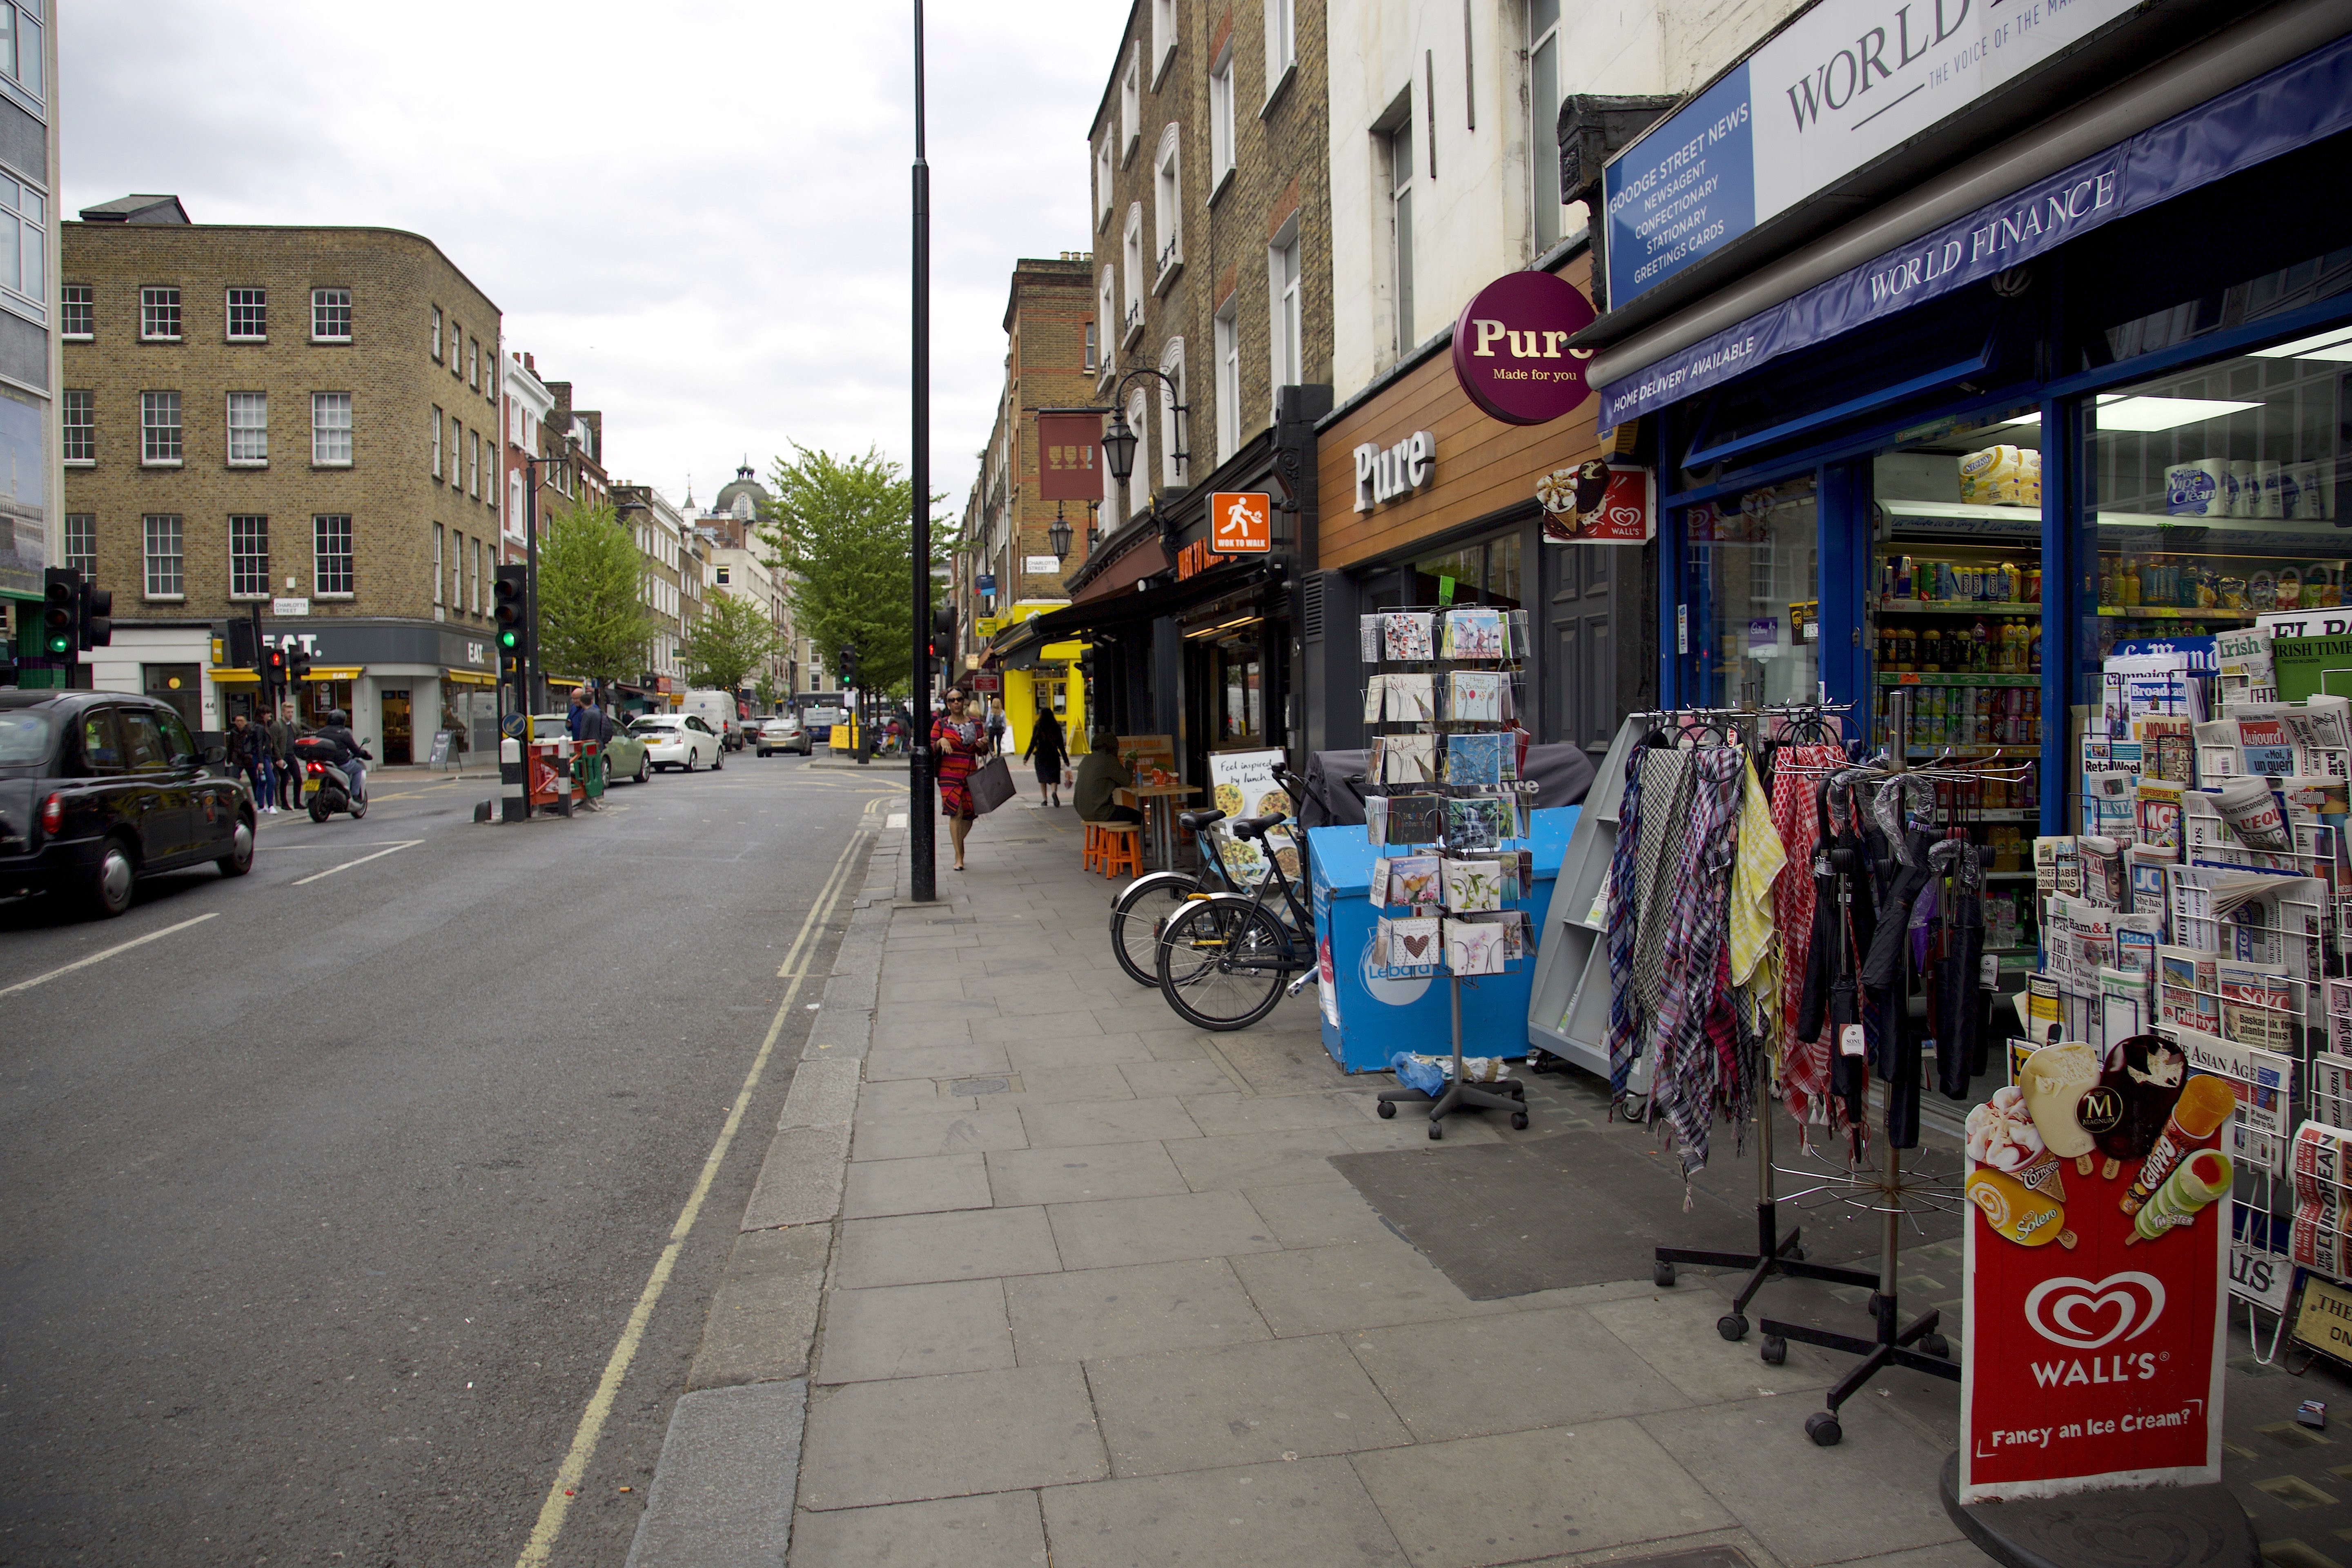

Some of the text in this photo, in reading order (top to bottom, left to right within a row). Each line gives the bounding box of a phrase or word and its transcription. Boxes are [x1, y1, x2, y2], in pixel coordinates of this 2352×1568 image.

[1929, 0, 2074, 89] THE VOICE OF THE MA
[1786, 0, 1971, 134] WORLD
[1610, 102, 1748, 215] GOODGE STREET NEWS
[1644, 160, 1706, 213] NEWSAGENT
[1635, 175, 1718, 240] CONFECTIONARY
[1646, 206, 1707, 255] STATIONARY
[1870, 169, 2115, 303] WORLD FINANCE
[1634, 219, 1724, 284] GREETINGS CARDS
[1493, 368, 1577, 383] Made for you
[1614, 336, 1755, 412] HOME DELIVERY AVAILABLE
[1353, 431, 1436, 513] Pure
[1965, 453, 1993, 474] NICKY
[2166, 475, 2201, 490] Wipe
[2172, 489, 2216, 504] Clean
[1611, 527, 1639, 535] WALL'S
[468, 642, 484, 664] EAT.
[2218, 636, 2261, 658] Irish
[2272, 643, 2312, 657] IRISH
[1389, 680, 1407, 691] Wife
[1466, 682, 1490, 691] Birthday!
[1470, 675, 1485, 684] Happy
[2132, 684, 2185, 697] Broadcast
[2243, 726, 2290, 745] Aujourd'
[2299, 722, 2310, 734] Fillon
[1388, 737, 1416, 754] Husband
[2265, 750, 2284, 760] «Moi,
[1221, 759, 1272, 772] Feel inspired
[2254, 760, 2267, 771] un
[1231, 777, 1240, 787] by
[2140, 788, 2172, 799] SUPERSPORT
[2293, 789, 2326, 805] Libération
[2094, 801, 2111, 814] THE
[2238, 795, 2273, 813] reconquête
[2038, 879, 2076, 888] CONDMNS
[2136, 868, 2160, 892] JC
[2135, 897, 2162, 908] 'She has
[2052, 937, 2068, 956] THE
[2074, 967, 2093, 978] 'Chaos'
[2074, 978, 2099, 991] the bins
[2104, 982, 2126, 1004] TLS
[2339, 1032, 2352, 1058] dello
[2192, 1046, 2256, 1081] ASIAN AGE
[2330, 1071, 2340, 1098] SERA
[2086, 1095, 2112, 1118] M
[2083, 1117, 2115, 1125] MAGNUM
[2256, 1110, 2274, 1123] leader's
[2267, 1122, 2276, 1131] Didi
[2140, 1134, 2177, 1190] Calippo
[2173, 1147, 2185, 1163] Orange
[2021, 1160, 2060, 1190] Cornetto
[2297, 1174, 2307, 1194] with
[2303, 1175, 2315, 1192] the
[2315, 1134, 2336, 1250] EUROPEAN
[2016, 1208, 2058, 1241] Solero
[2316, 1250, 2325, 1268] THE
[2324, 1250, 2334, 1273] NEW
[2030, 1352, 2156, 1388] WALL'S
[1992, 1408, 2190, 1448] Fancy an Ice Cream?
